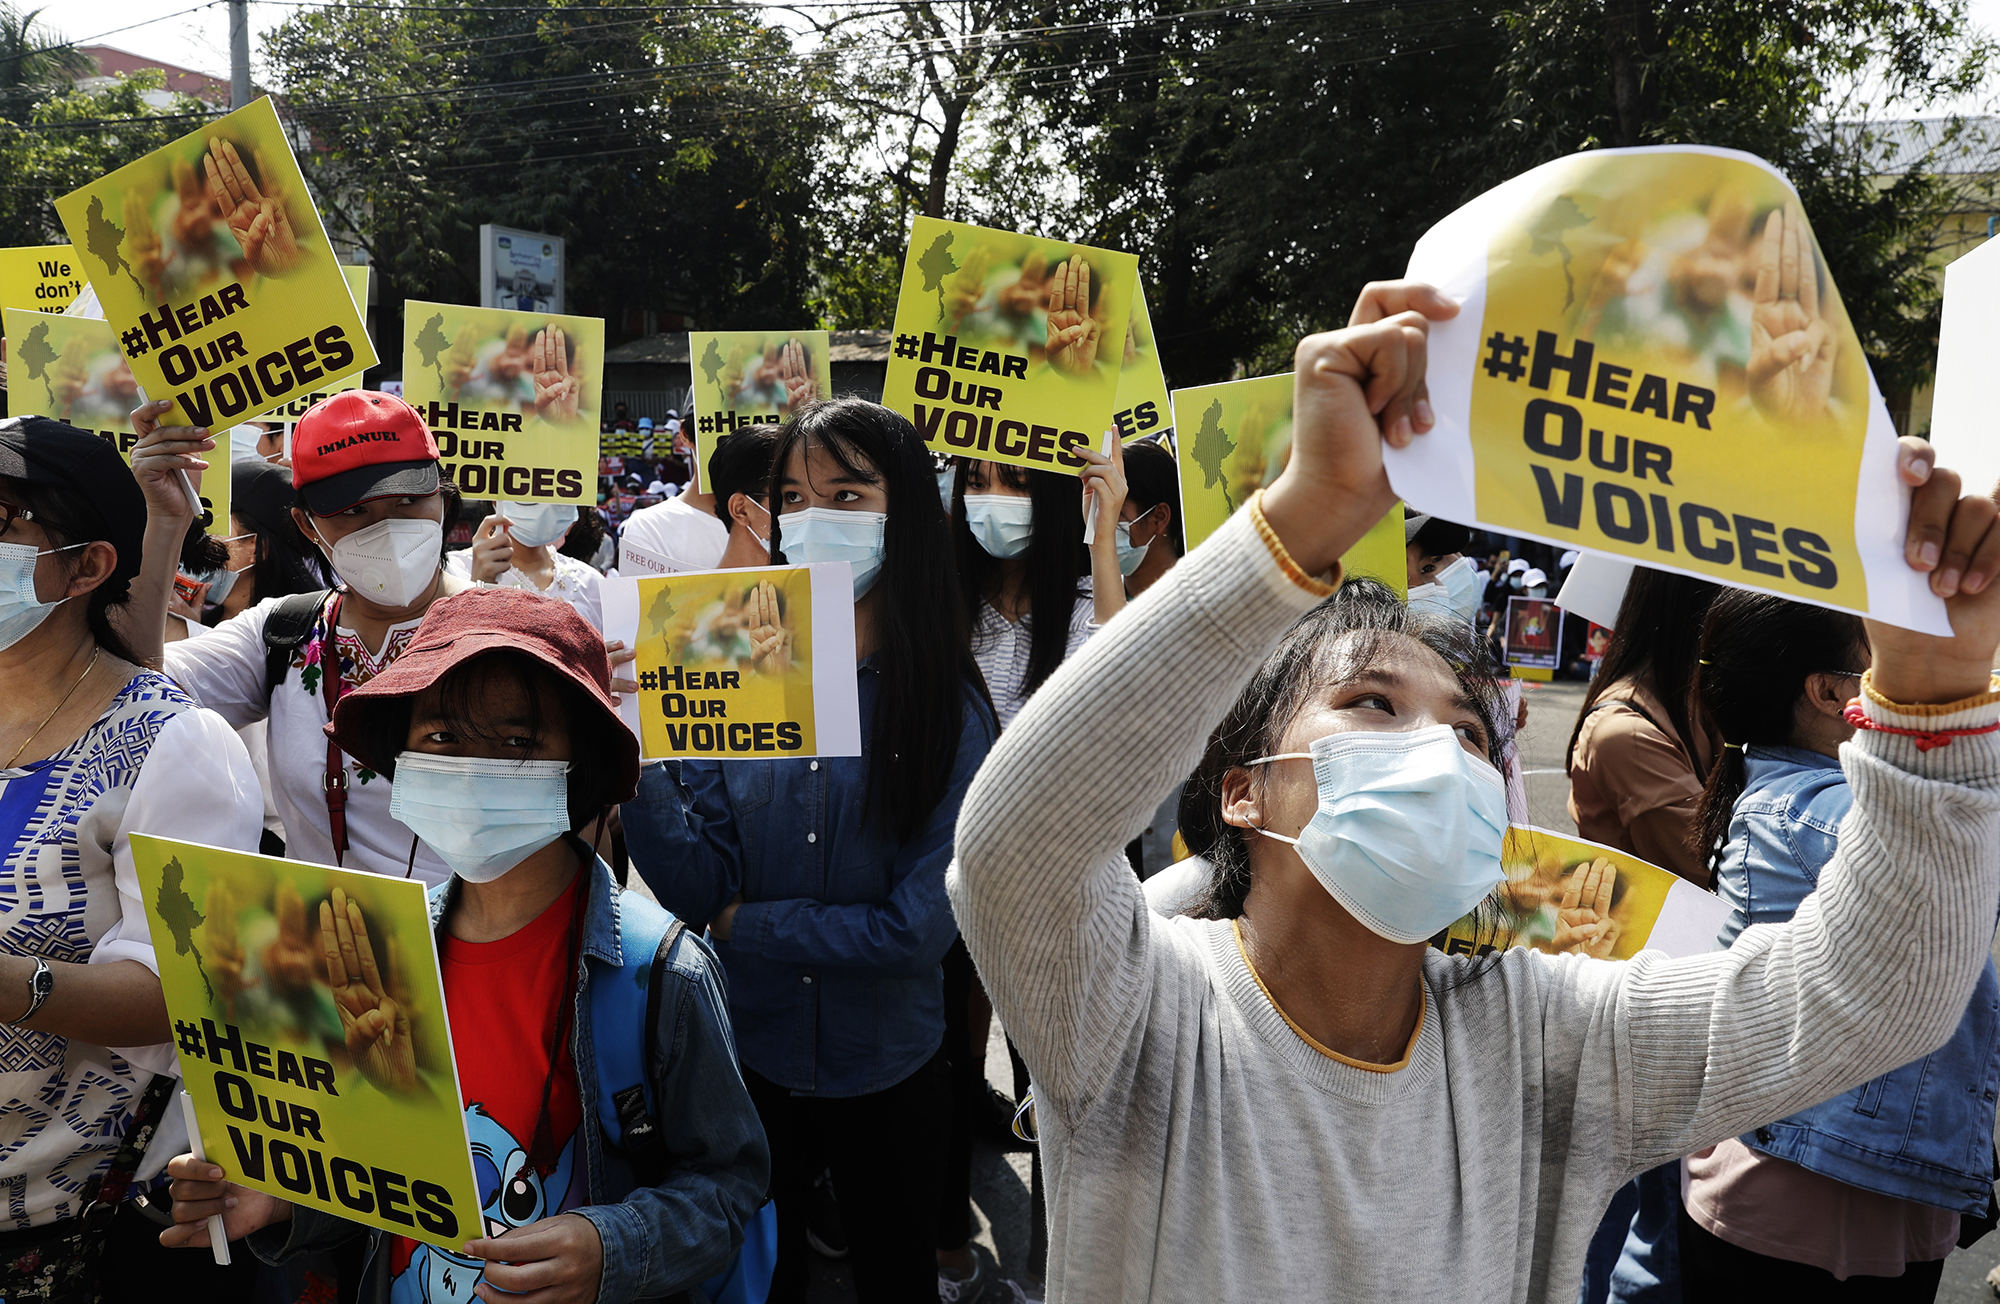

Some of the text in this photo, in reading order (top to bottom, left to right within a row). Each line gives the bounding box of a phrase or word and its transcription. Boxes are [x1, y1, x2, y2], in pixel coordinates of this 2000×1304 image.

[35, 280, 82, 299] don't
[38, 260, 71, 278] We
[121, 282, 250, 360] #HEAR
[158, 330, 249, 386] OUR
[176, 325, 354, 428] VOICES
[894, 331, 1028, 381] #HEAR
[1483, 329, 1716, 431] #HEAR
[914, 366, 1003, 411] OUR
[317, 431, 400, 456] IMMANUEL
[431, 430, 505, 461] OUR
[913, 403, 1090, 468] VOICES
[1523, 397, 1675, 487] OUR
[1529, 463, 1838, 590] VOICES
[626, 549, 666, 574] FREE OUR
[639, 665, 740, 691] #HEAR
[661, 693, 727, 718] OUR
[665, 721, 802, 751] VOICES
[174, 1017, 340, 1097] #HEAR
[213, 1070, 326, 1143] OUR
[226, 1124, 459, 1239] VOICES
